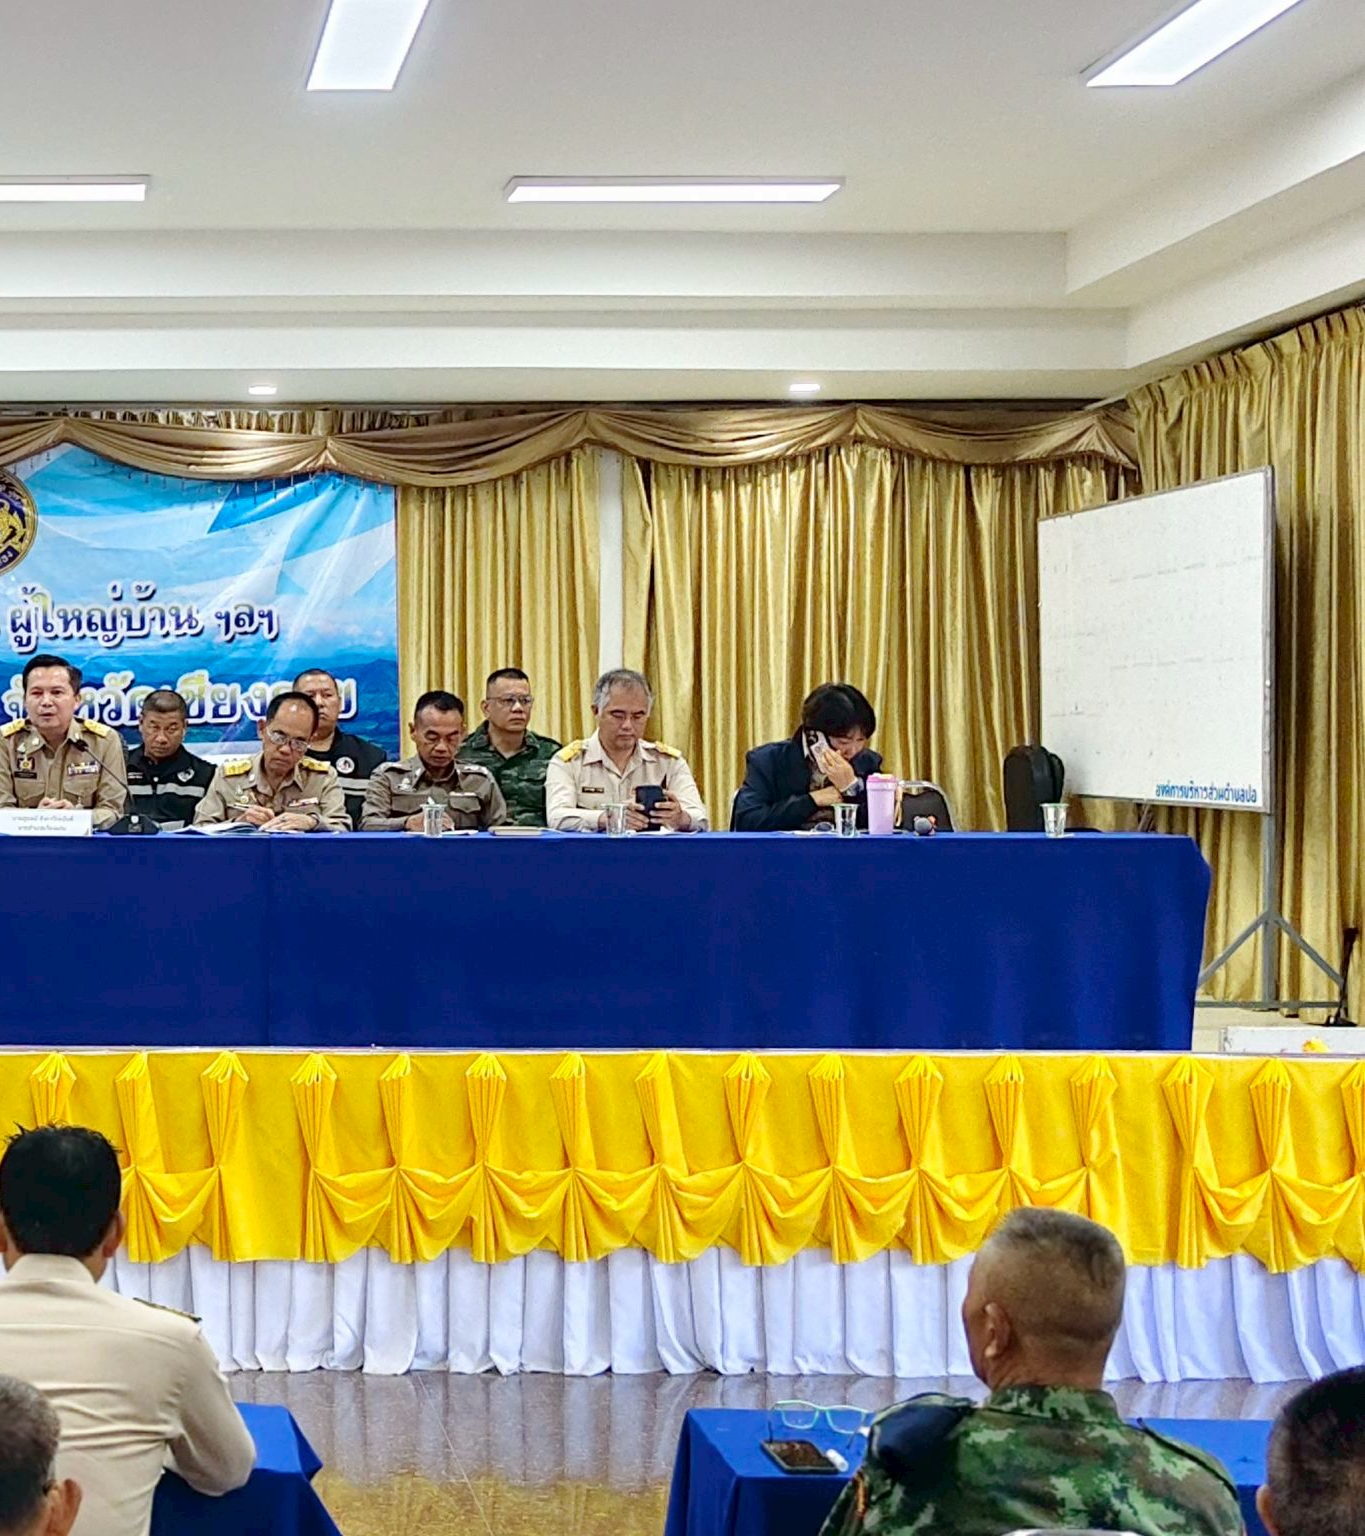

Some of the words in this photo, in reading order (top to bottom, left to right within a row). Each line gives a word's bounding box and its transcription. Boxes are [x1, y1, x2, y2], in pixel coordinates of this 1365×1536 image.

[8, 582, 203, 654] ผู้ใหญ่บ้าน
